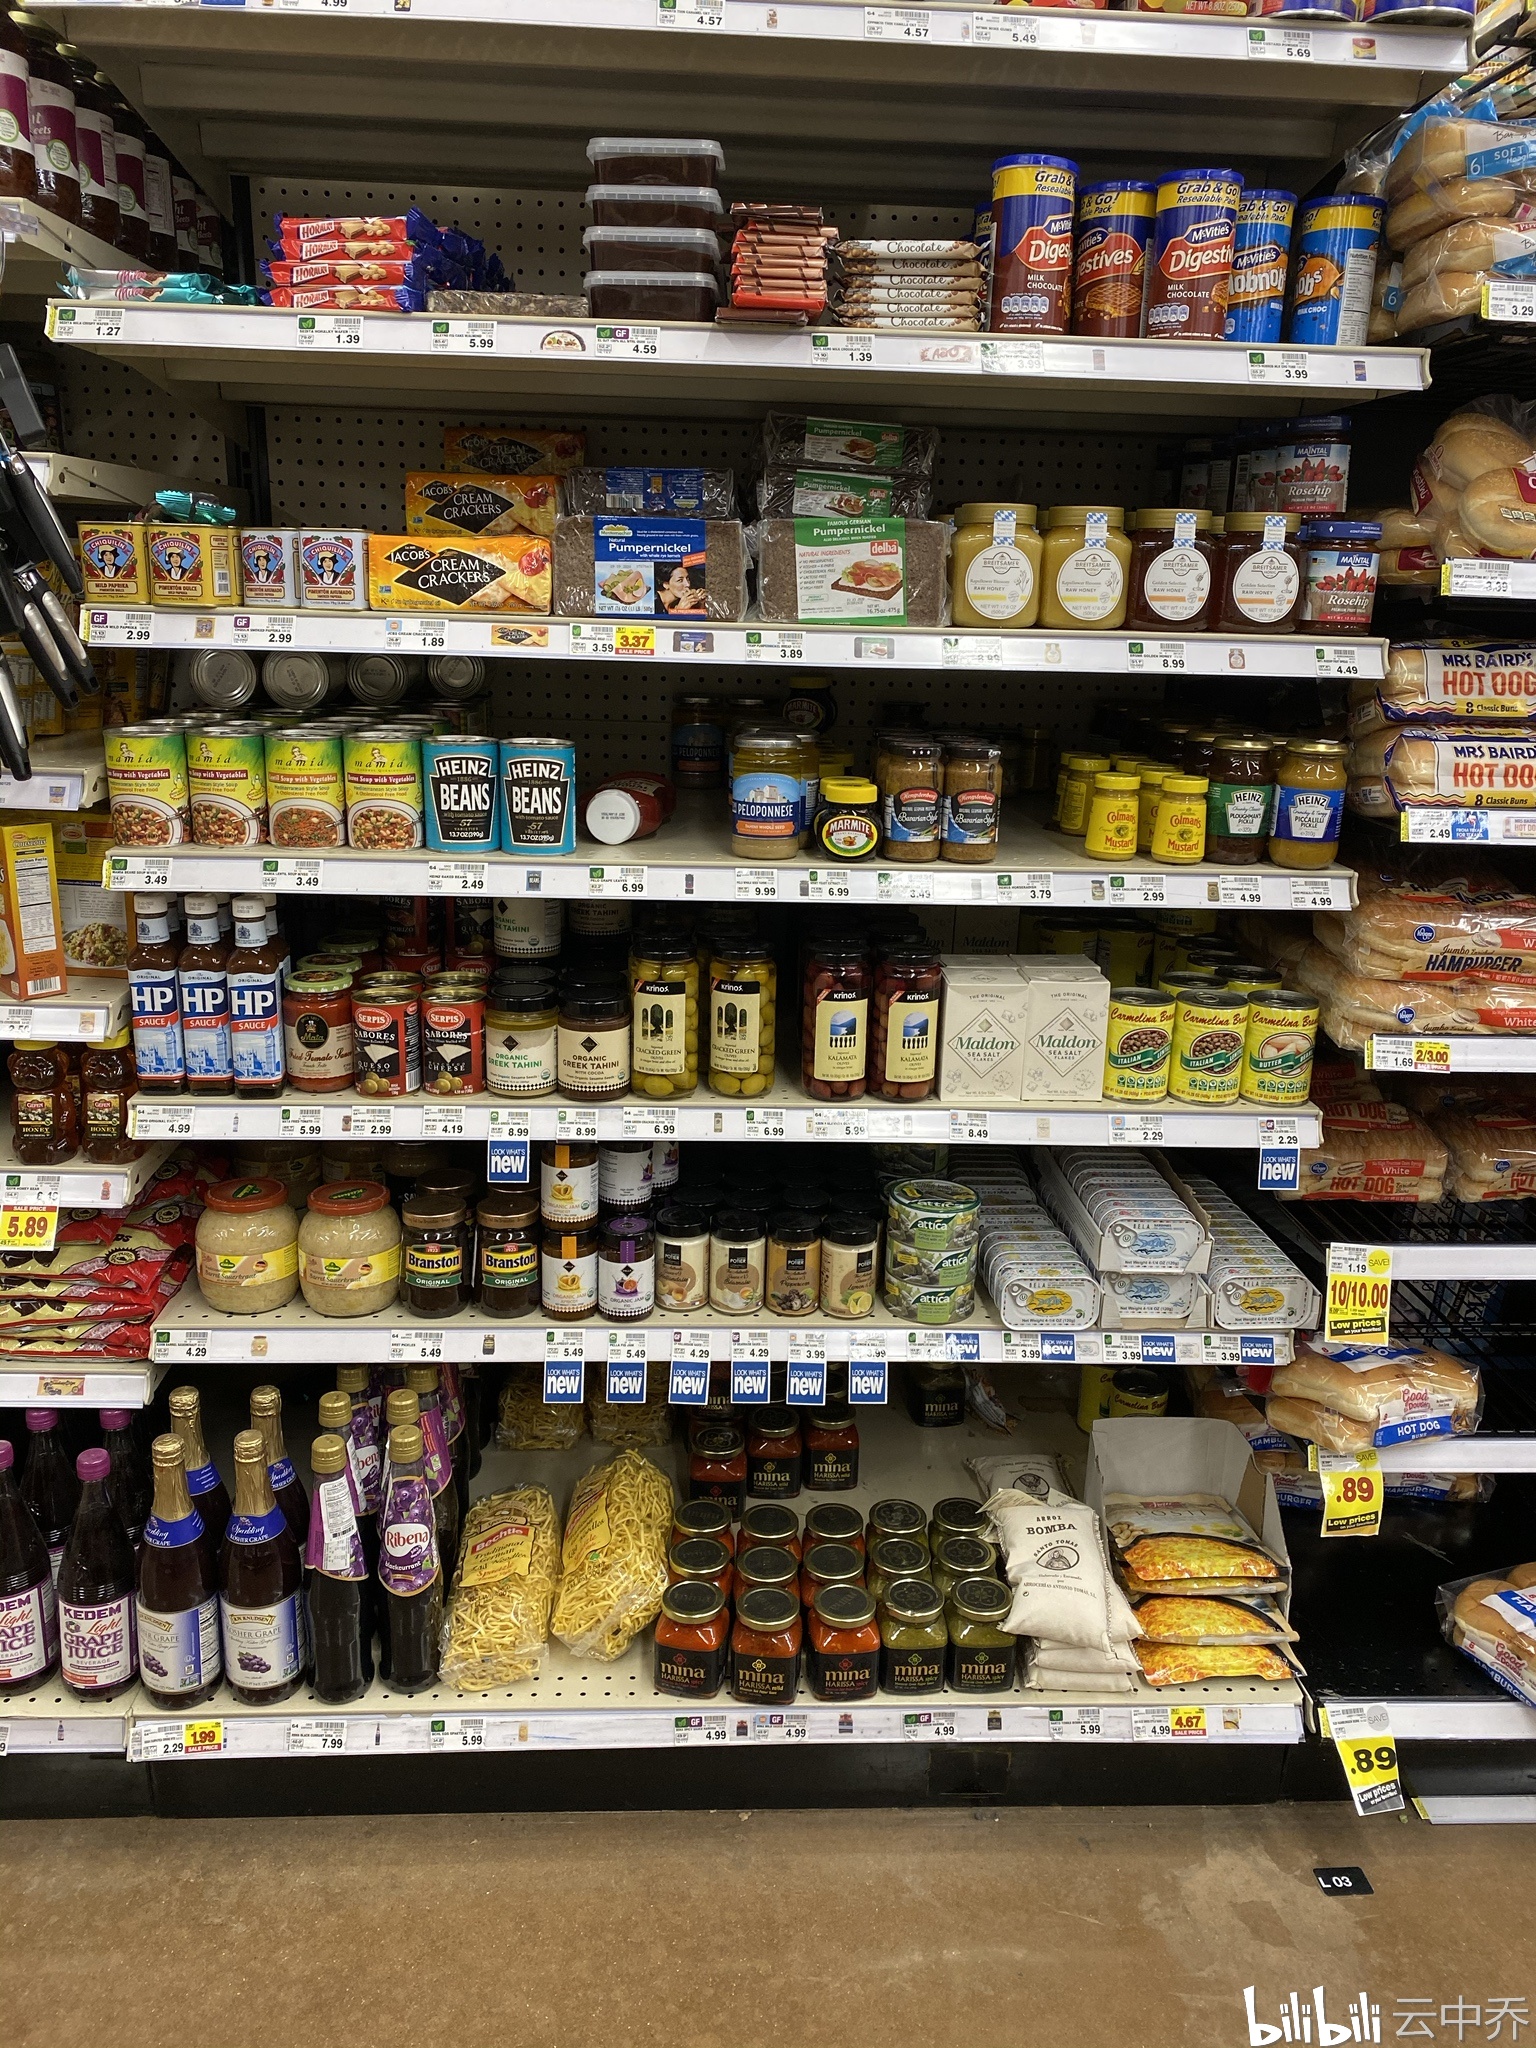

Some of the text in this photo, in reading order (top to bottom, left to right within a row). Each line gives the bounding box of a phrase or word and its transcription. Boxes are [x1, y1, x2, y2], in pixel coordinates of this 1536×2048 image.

[697, 15, 723, 26] 4.57
[904, 27, 929, 37] 4.57
[1012, 33, 1037, 43] 5.49
[1287, 48, 1311, 57] 5.69
[1470, 145, 1523, 175] 6 SOFT
[1177, 182, 1222, 195] Grab &
[1177, 195, 1222, 203] Resealable
[887, 241, 944, 254] Chocolate
[1027, 282, 1062, 292] CHOCOLATE
[1512, 306, 1533, 315] 3.29
[96, 326, 121, 336] 1.27
[615, 328, 628, 338] GF
[336, 335, 359, 343] 1.39
[469, 338, 494, 348] 5.99
[632, 344, 657, 355] 4.59
[850, 353, 872, 361] 1.39
[1285, 370, 1308, 378] 3.99
[610, 543, 690, 553] Pumpernickel
[872, 542, 897, 553] delba
[391, 551, 430, 563] JACOB'S
[431, 560, 479, 572] CREAM
[418, 572, 490, 588] CRACKERS
[1328, 594, 1369, 607] Rosehip
[127, 631, 149, 640] 2.99
[269, 634, 292, 642] 2.99
[422, 637, 444, 646] 1.89
[620, 636, 649, 647] 3.37
[593, 644, 613, 652] 3.59
[780, 649, 802, 658] 3.89
[1163, 659, 1184, 668] 8.99
[1443, 652, 1533, 668] MRS BAIRD'S
[1337, 666, 1358, 675] 4.49
[1443, 671, 1485, 695] HOT
[1466, 702, 1474, 714] 8
[439, 760, 489, 776] HEINZ
[390, 775, 415, 783] Vegetables
[440, 784, 490, 811] BEANS
[512, 787, 562, 814] BEANS
[738, 803, 793, 817] PELOPONNESE
[830, 820, 870, 833] MARMITE
[1430, 829, 1450, 838] 2.49
[1105, 835, 1134, 848] Mustard
[145, 876, 167, 884] 3.49
[296, 877, 319, 886] 3.49
[462, 880, 484, 889] 2.49
[622, 882, 643, 892] 6.99
[755, 887, 776, 896] 9.99
[828, 888, 849, 896] 6.99
[1030, 889, 1051, 899] 3.79
[1143, 892, 1164, 901] 2.99
[1240, 894, 1260, 902] 4.99
[1311, 897, 1332, 906] 4.99
[1440, 945, 1469, 955] Jumbo
[1426, 955, 1522, 972] HAMBURGER
[131, 986, 173, 1012] HP
[139, 1018, 165, 1026] SAUCE
[358, 1014, 386, 1024] SERPIS
[354, 1030, 395, 1040] SABORES
[955, 1037, 1015, 1050] Maldon
[496, 1053, 528, 1061] ORGANIC
[1118, 1054, 1142, 1065] ITALIAN
[1416, 1048, 1448, 1062] 2/3.00
[489, 1059, 509, 1068] GREEK
[1259, 1058, 1283, 1068] BUTTER
[1394, 1058, 1413, 1067] 1.69
[169, 1124, 190, 1133] 4.99
[300, 1126, 321, 1135] 5.99
[371, 1125, 391, 1134] 2.99
[442, 1125, 463, 1134] 4.19
[508, 1127, 528, 1137] 8.99
[576, 1128, 596, 1137] 8.99
[654, 1124, 675, 1134] 6.99
[764, 1127, 784, 1136] 6.99
[969, 1129, 988, 1138] 8.49
[1142, 1131, 1163, 1141] 2.29
[1278, 1135, 1298, 1145] 2.29
[1262, 1161, 1294, 1182] new
[8, 1217, 48, 1238] 5.89
[917, 1220, 948, 1230] attica
[409, 1253, 459, 1269] Branston
[1368, 1258, 1390, 1267] SAVE!
[1348, 1264, 1366, 1273] 1.19
[1331, 1281, 1387, 1309] 10/10.00
[1331, 1319, 1381, 1330] Low prices
[186, 1347, 207, 1357] 4.29
[421, 1348, 441, 1358] 5.49
[564, 1348, 583, 1357] 5.49
[626, 1350, 646, 1358] 5.49
[690, 1348, 710, 1358] 4.29
[807, 1350, 825, 1359] 3.99
[1022, 1350, 1041, 1358] 3.99
[1122, 1351, 1141, 1360] 3.99
[1221, 1353, 1240, 1362] 3.99
[1355, 1453, 1377, 1462] SAVE!
[1336, 1477, 1374, 1502] .89
[1026, 1523, 1077, 1535] BOMBA
[386, 1530, 429, 1547] Ribena
[475, 1528, 523, 1553] Bechtle
[1034, 1539, 1078, 1557] SANTO TOMAS
[64, 1606, 122, 1619] KEDEM
[86, 1617, 122, 1635] Light
[64, 1628, 124, 1648] GRAPE
[66, 1642, 123, 1659] JUICE
[661, 1662, 706, 1679] mina
[662, 1674, 690, 1683] HARISSA
[1175, 1716, 1200, 1729] 4.67
[1368, 1714, 1387, 1724] SAVE!
[786, 1729, 806, 1738] 4.99
[935, 1725, 954, 1737] 4.99
[1080, 1724, 1100, 1735] 5.99
[1151, 1724, 1170, 1736] 4.99
[706, 1731, 726, 1740] 4.99
[322, 1739, 343, 1749] 7.99
[462, 1736, 482, 1746] 5.99
[164, 1744, 184, 1753] 2.29
[1318, 1876, 1352, 1889] L 03
